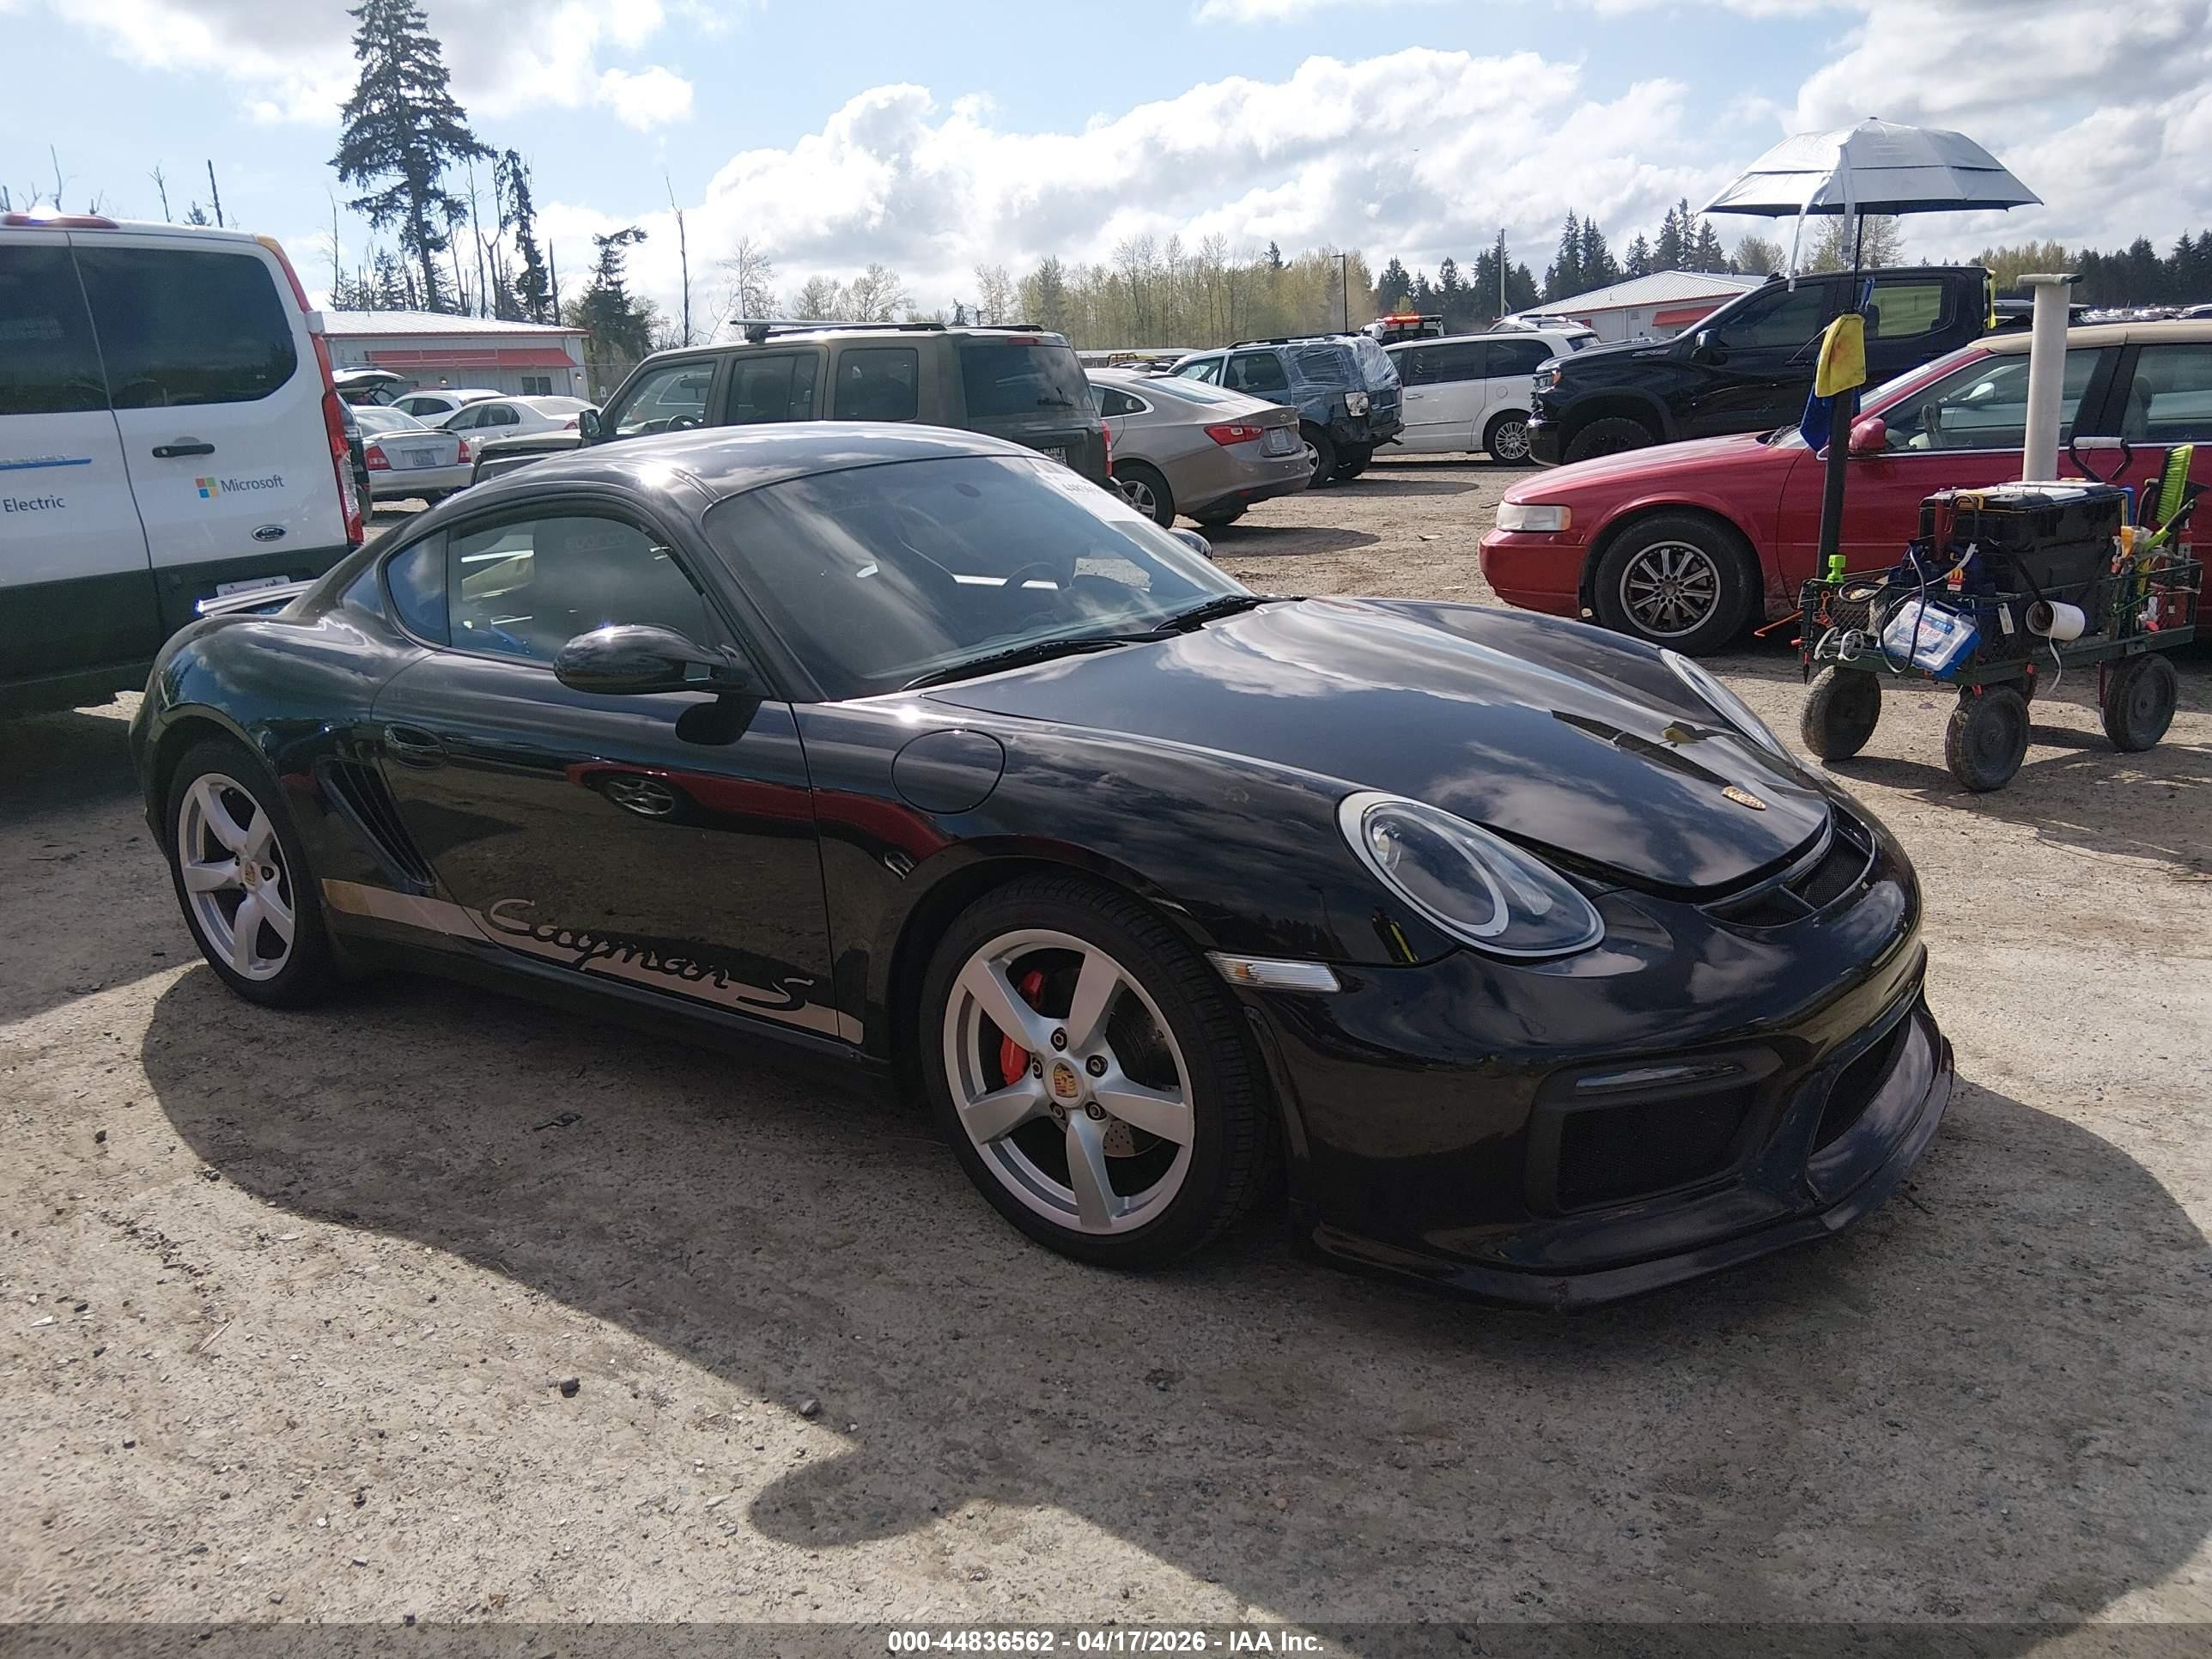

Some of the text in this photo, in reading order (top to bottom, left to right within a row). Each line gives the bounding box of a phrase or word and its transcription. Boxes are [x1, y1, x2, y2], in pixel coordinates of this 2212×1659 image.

[220, 474, 284, 492] Microsoft
[3, 495, 66, 513] Electric
[483, 898, 815, 1012] Cayman S
